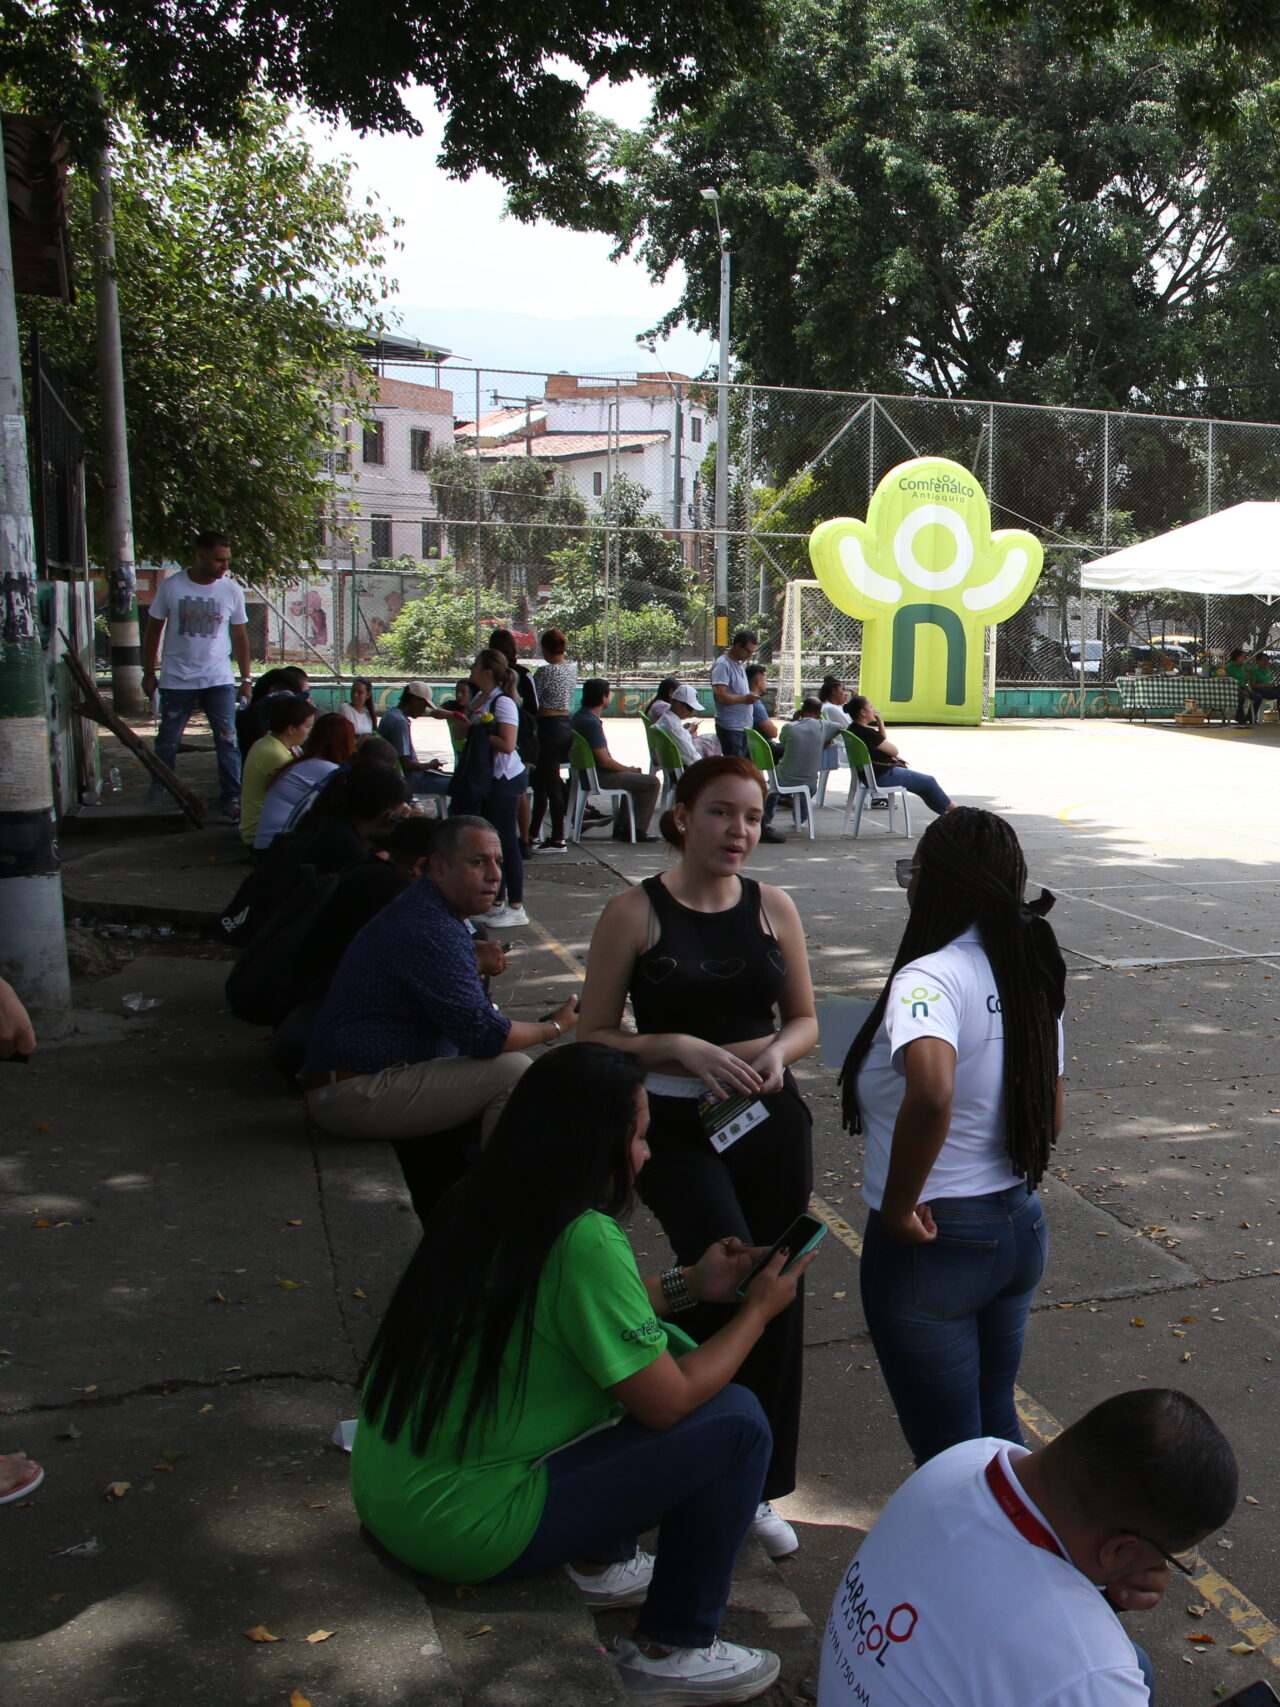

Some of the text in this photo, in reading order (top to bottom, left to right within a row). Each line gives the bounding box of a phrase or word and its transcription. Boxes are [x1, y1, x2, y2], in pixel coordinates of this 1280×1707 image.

[899, 476, 974, 497] Comfenalco
[912, 491, 965, 503] Antioquia
[845, 1560, 891, 1668] CARACOL
